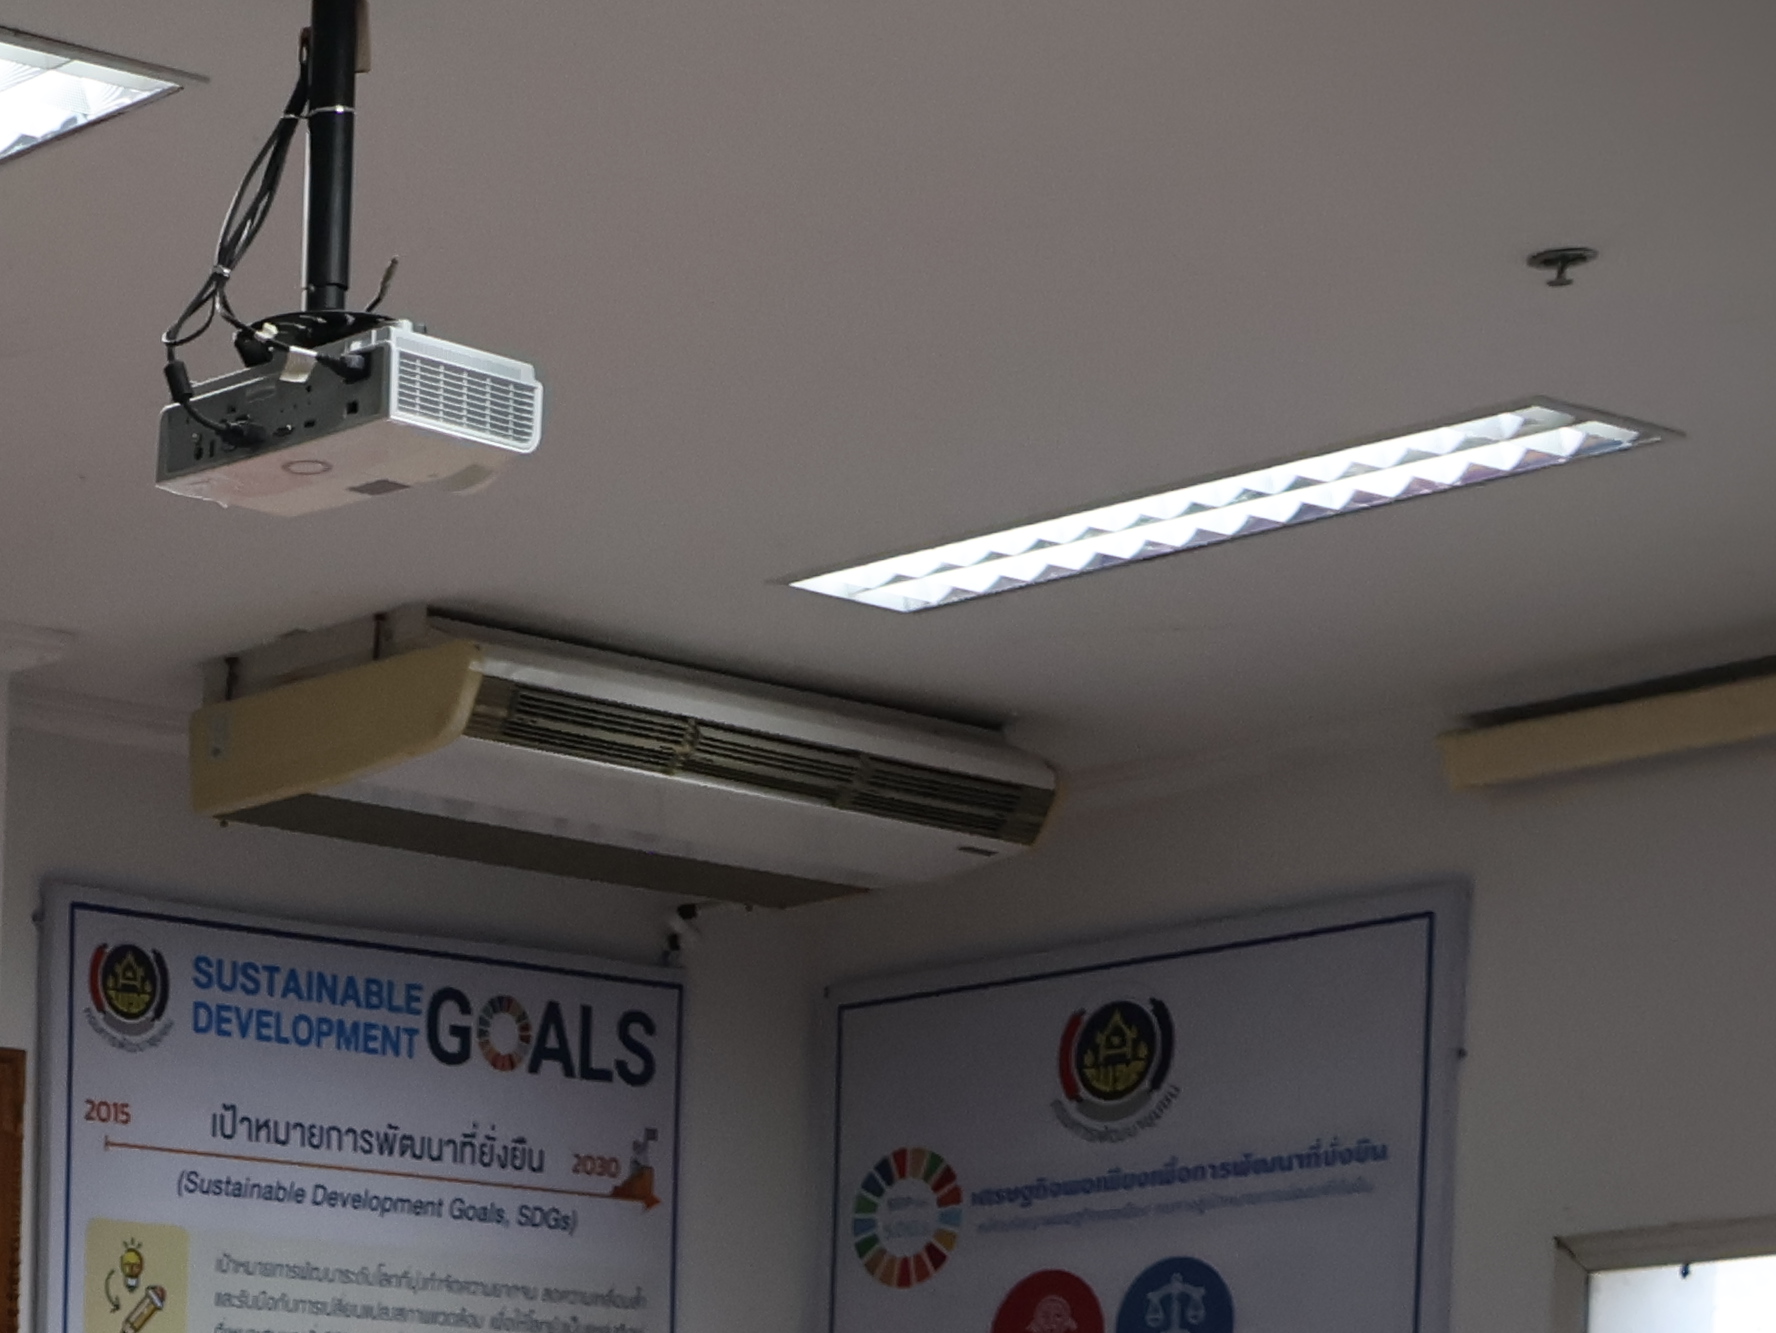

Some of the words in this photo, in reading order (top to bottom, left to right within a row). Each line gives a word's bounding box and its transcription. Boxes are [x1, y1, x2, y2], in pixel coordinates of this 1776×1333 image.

[193, 954, 424, 1017] SUSTAINABLE
[193, 1001, 419, 1060] DEVELOPMENT
[426, 986, 656, 1087] GOALS
[84, 1099, 131, 1124] 2015
[571, 1152, 621, 1178] 2030
[311, 1182, 443, 1218] Development
